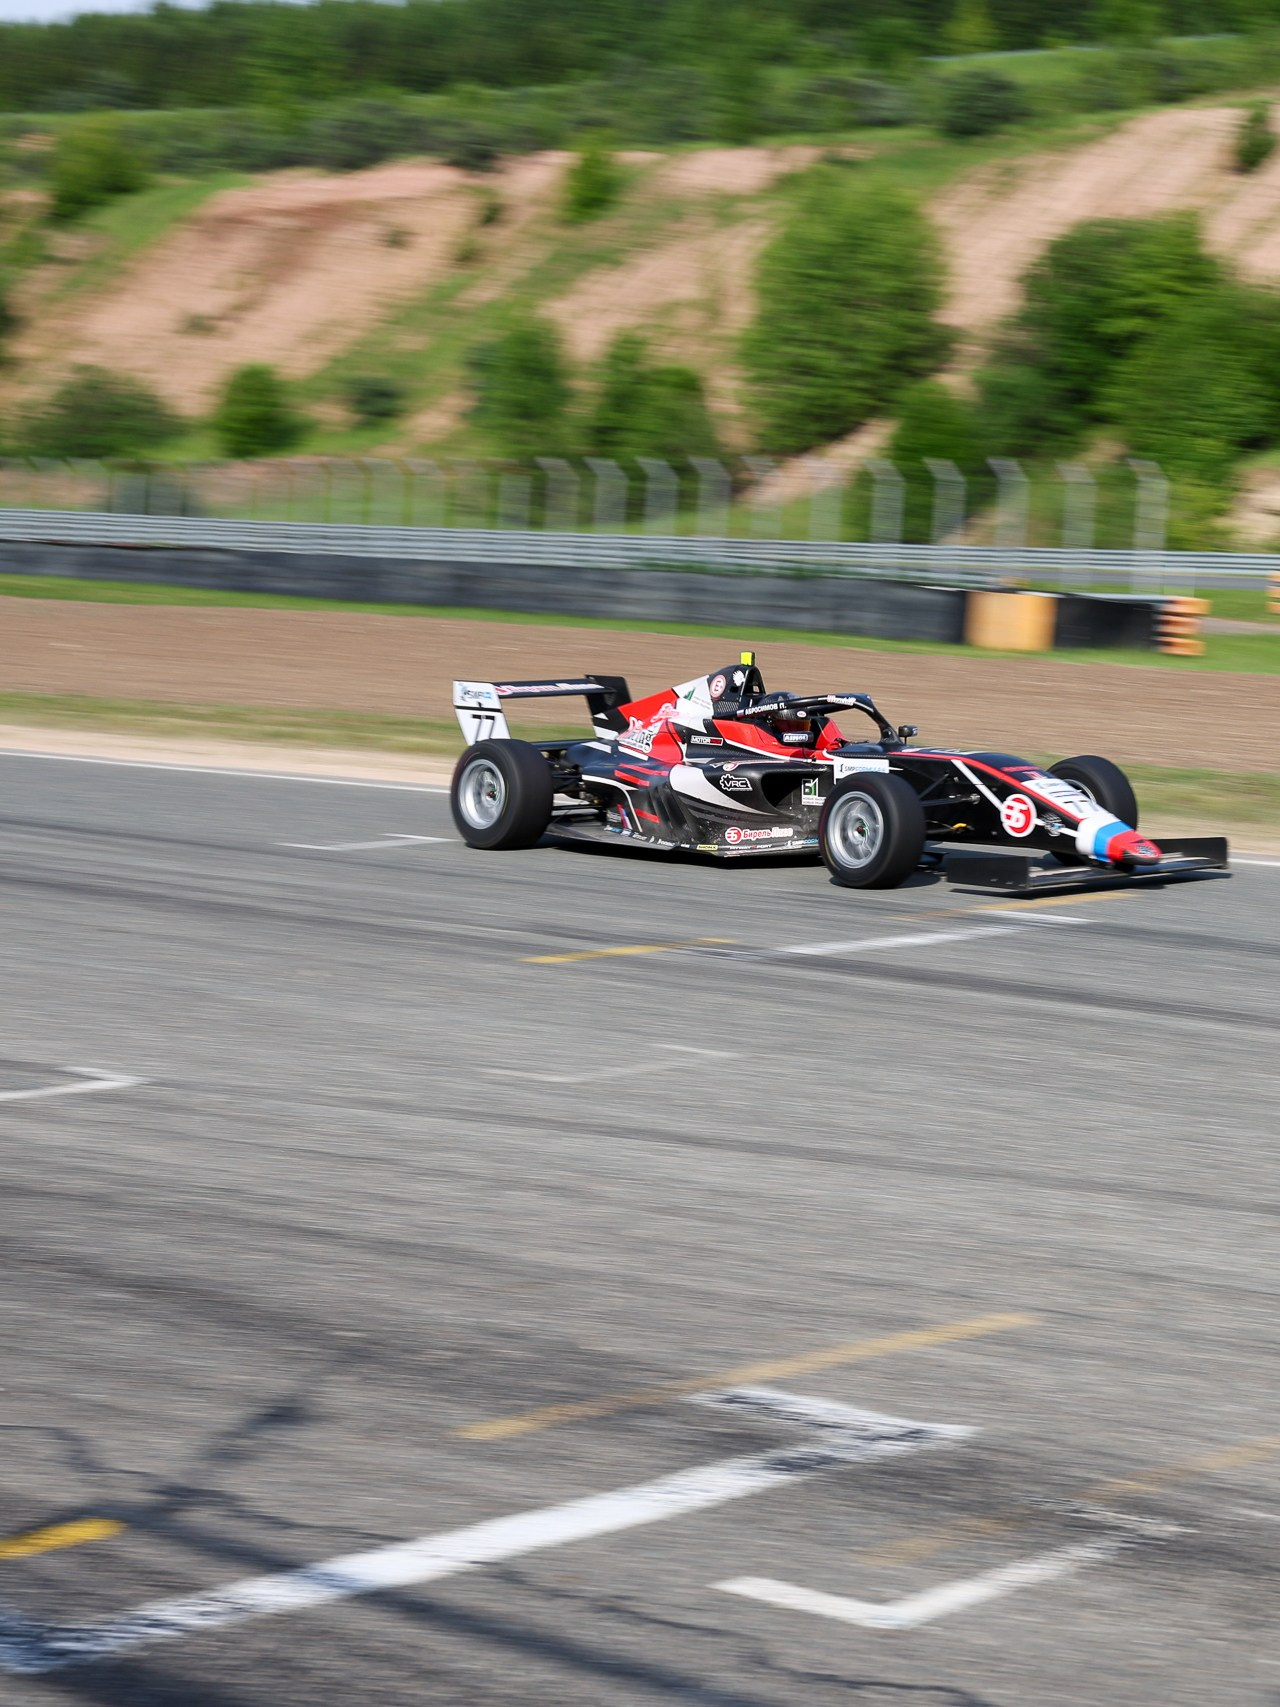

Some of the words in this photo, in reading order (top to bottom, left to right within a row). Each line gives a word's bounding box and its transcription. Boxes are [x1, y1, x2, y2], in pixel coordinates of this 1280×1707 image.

[744, 703, 778, 716] АБРОСИМОВ
[471, 713, 496, 741] 77
[724, 780, 747, 788] VRC
[743, 830, 771, 840] Бирель
